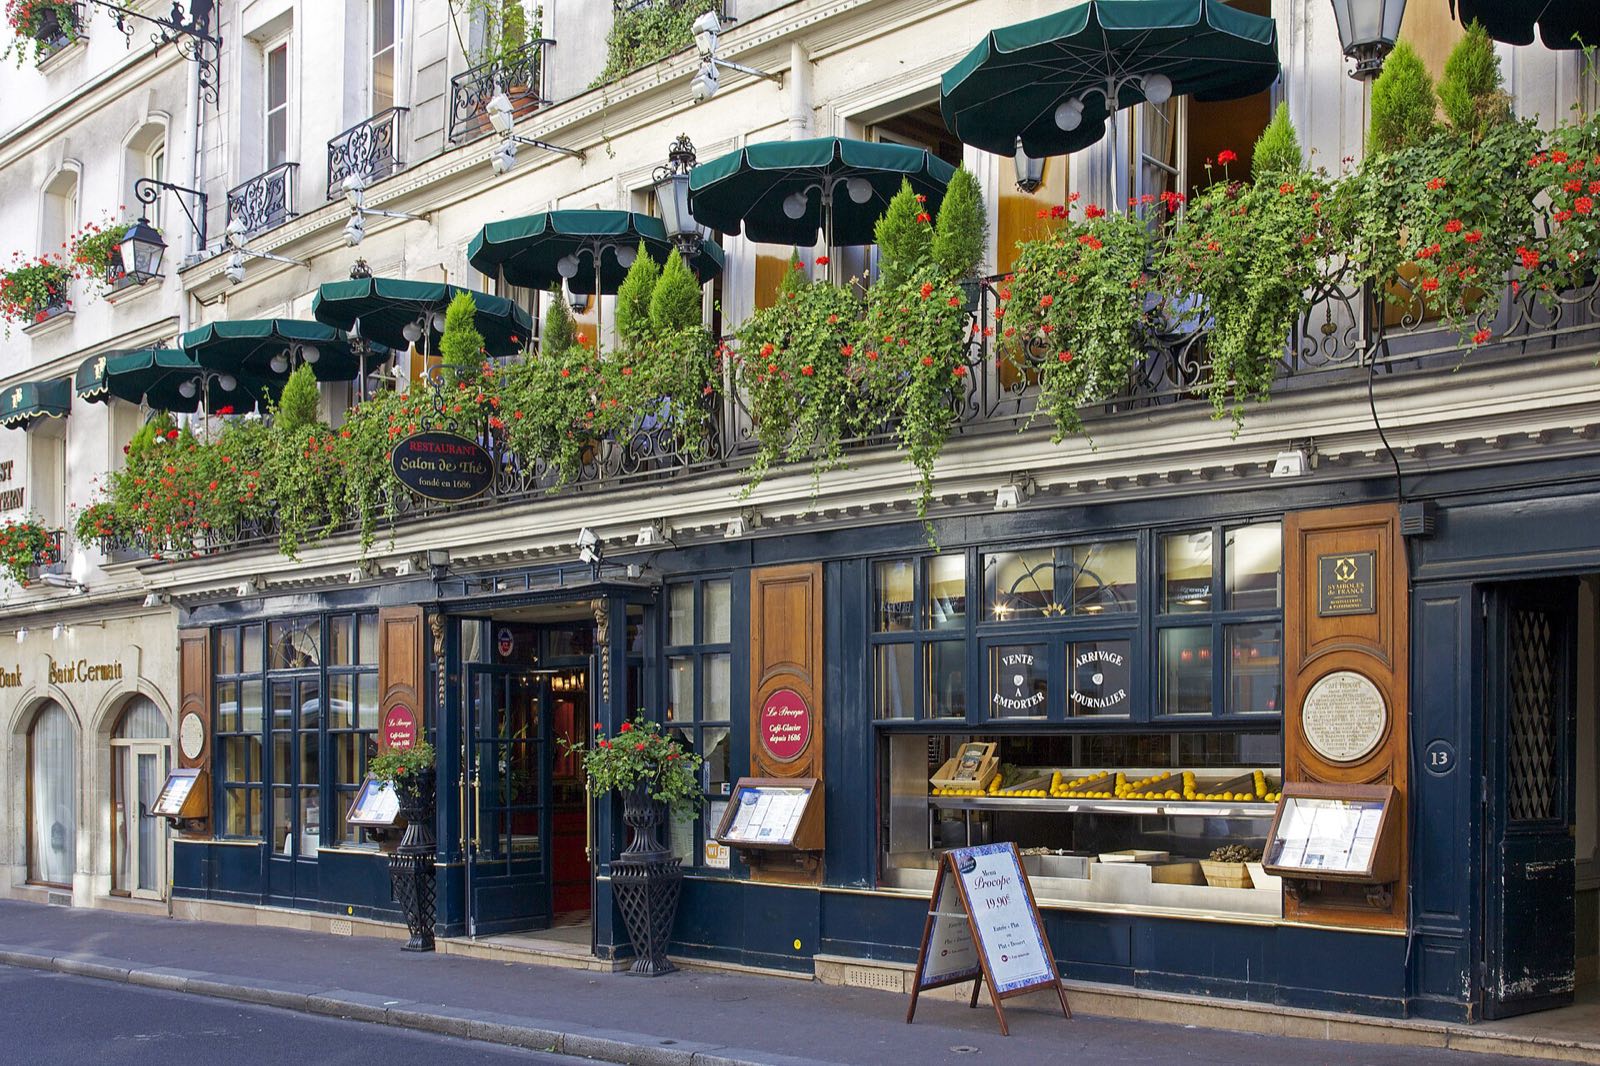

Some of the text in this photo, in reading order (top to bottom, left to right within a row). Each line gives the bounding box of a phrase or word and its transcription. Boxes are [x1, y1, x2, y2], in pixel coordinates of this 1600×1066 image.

[409, 441, 476, 455] RESTAURANT
[400, 456, 435, 471] Salon
[439, 458, 456, 472] de
[419, 477, 439, 487] fondé
[453, 480, 471, 488] 1686
[1337, 587, 1364, 595] FRANCE
[1002, 654, 1034, 666] VENTE
[1075, 650, 1123, 668] ARRIVAGE
[77, 659, 122, 683] Germain
[1015, 688, 1021, 697] A
[1070, 689, 1126, 708] JOURNALIER
[993, 691, 1045, 710] EMPORTER
[766, 706, 777, 717] Le
[769, 723, 801, 734] Café-Glacier
[769, 733, 801, 744] depuis 1686
[1431, 751, 1448, 766] 13
[974, 875, 1011, 891] Procope
